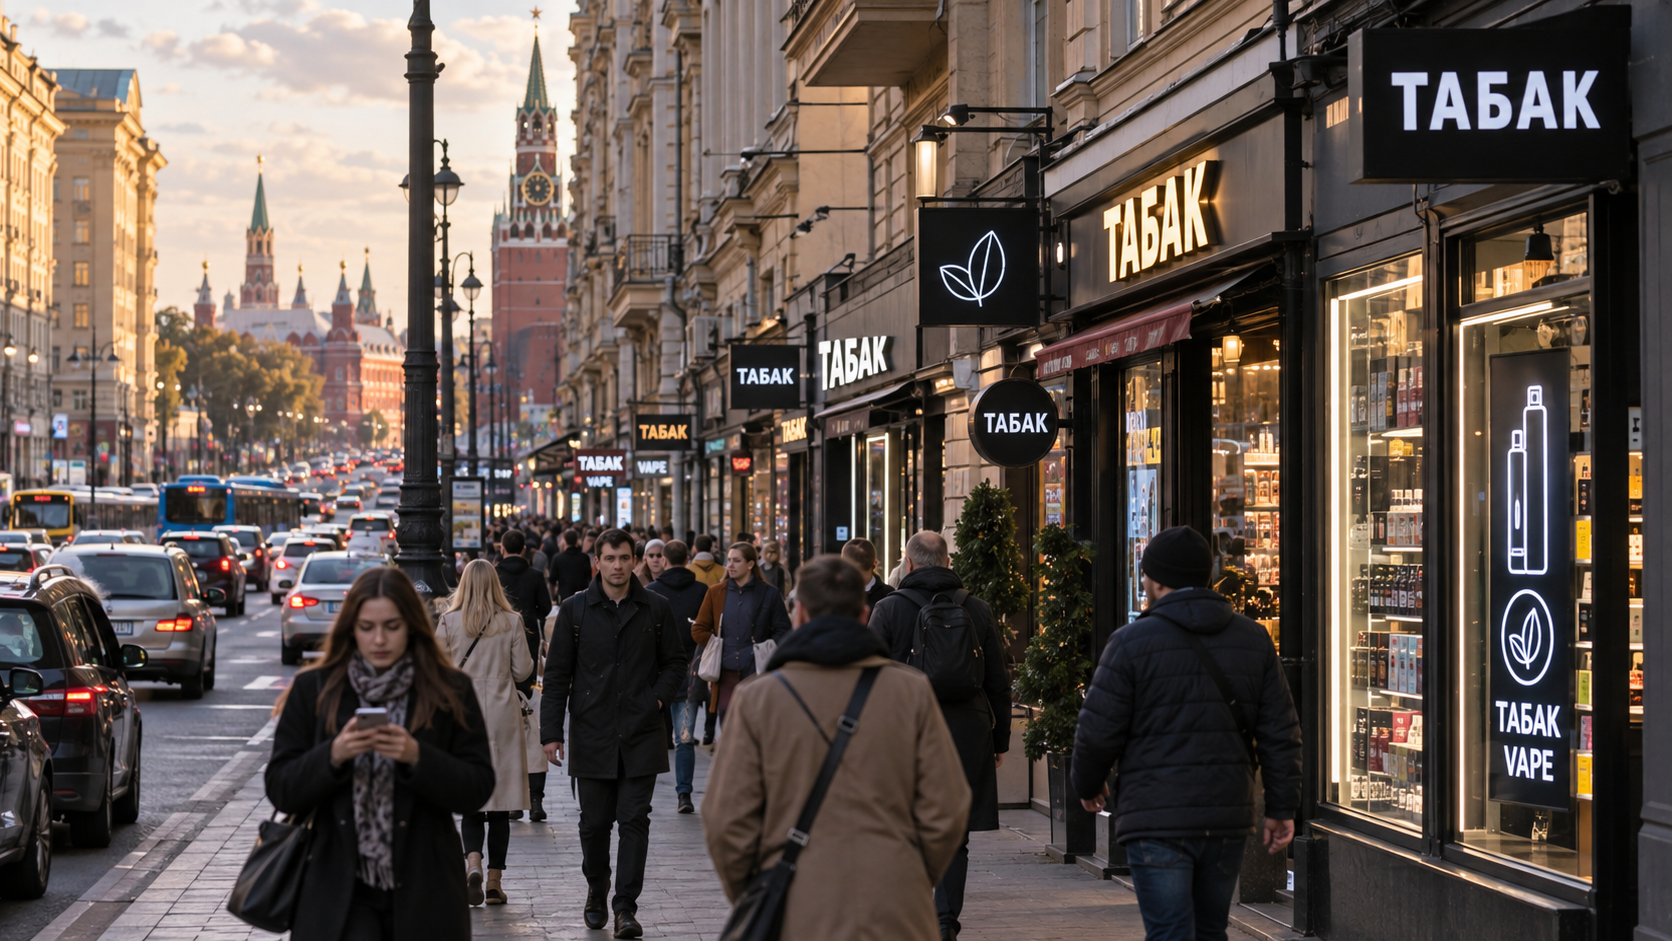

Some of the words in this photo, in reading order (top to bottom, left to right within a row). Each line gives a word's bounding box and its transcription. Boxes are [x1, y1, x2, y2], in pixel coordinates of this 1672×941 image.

[1391, 70, 1602, 131] ТАБАК
[1104, 160, 1210, 283] ТАБАК
[818, 335, 888, 391] ТАБАК
[736, 367, 794, 385] ТАБАК
[638, 424, 689, 440] ТАБАК
[781, 416, 808, 443] ТАБАК
[983, 412, 1049, 434] ТАБАК
[577, 455, 624, 471] ТАБАК
[636, 460, 668, 475] VAPE
[585, 475, 614, 488] VAPE
[1495, 700, 1562, 739] ТАБАК
[1503, 744, 1555, 783] VAPE
